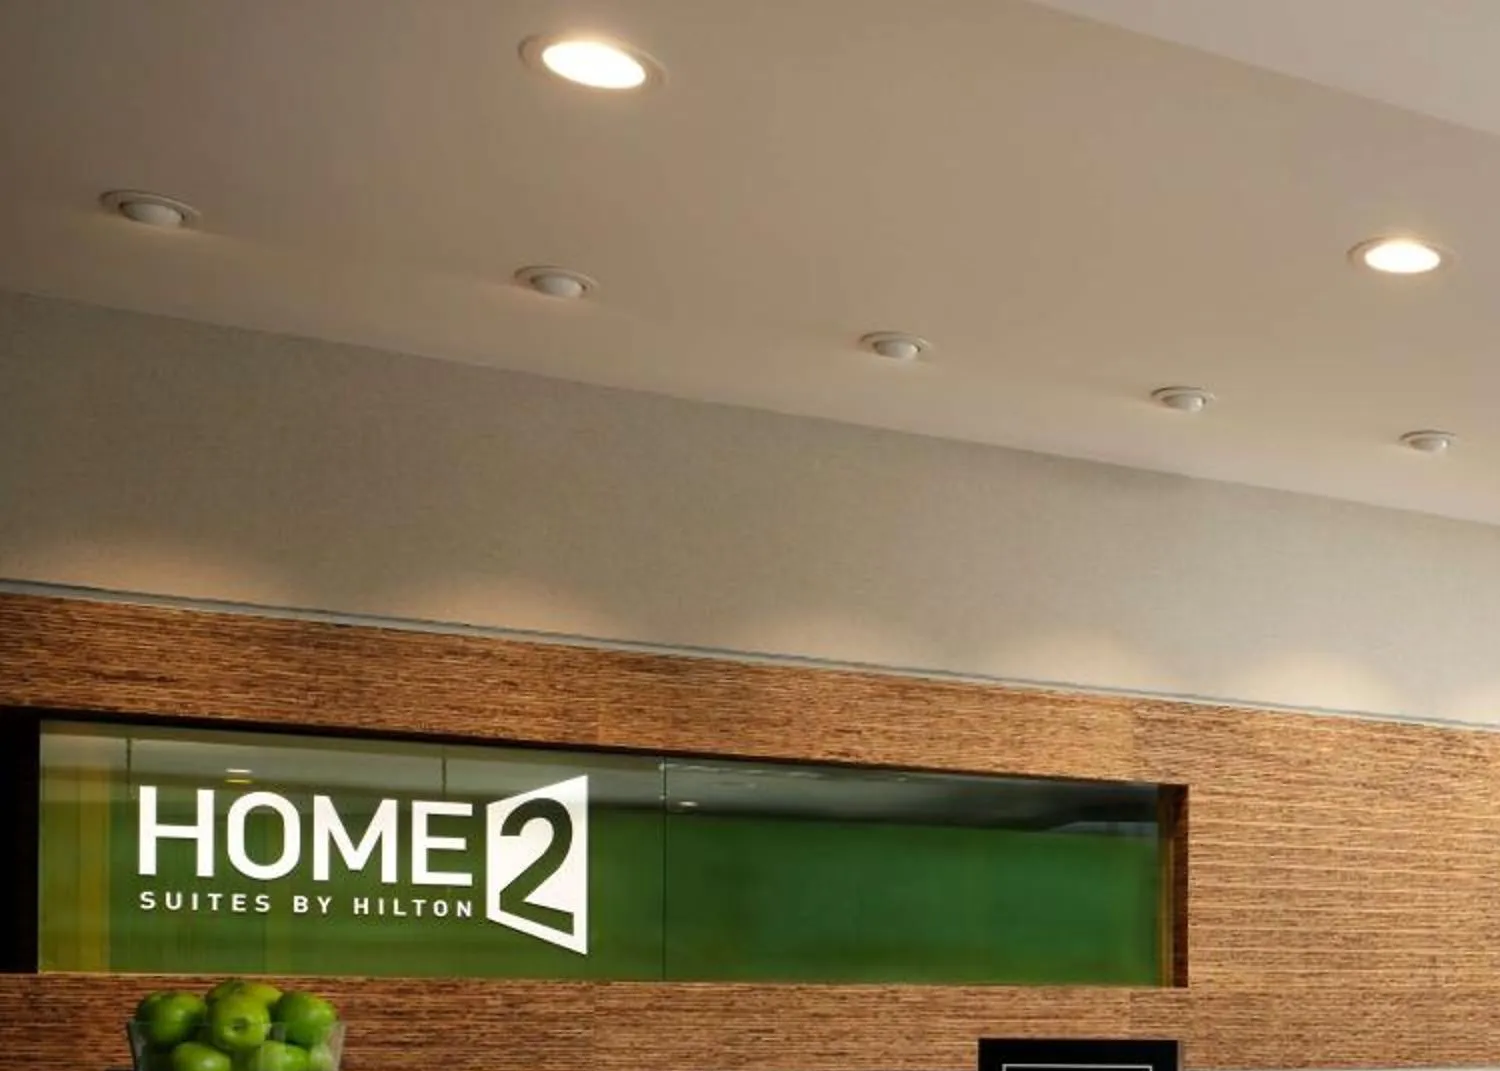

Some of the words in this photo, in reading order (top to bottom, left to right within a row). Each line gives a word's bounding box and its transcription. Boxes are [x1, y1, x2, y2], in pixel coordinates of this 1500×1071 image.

[139, 890, 272, 913] SUITES
[292, 895, 334, 915] BY
[353, 896, 473, 918] HILTON
